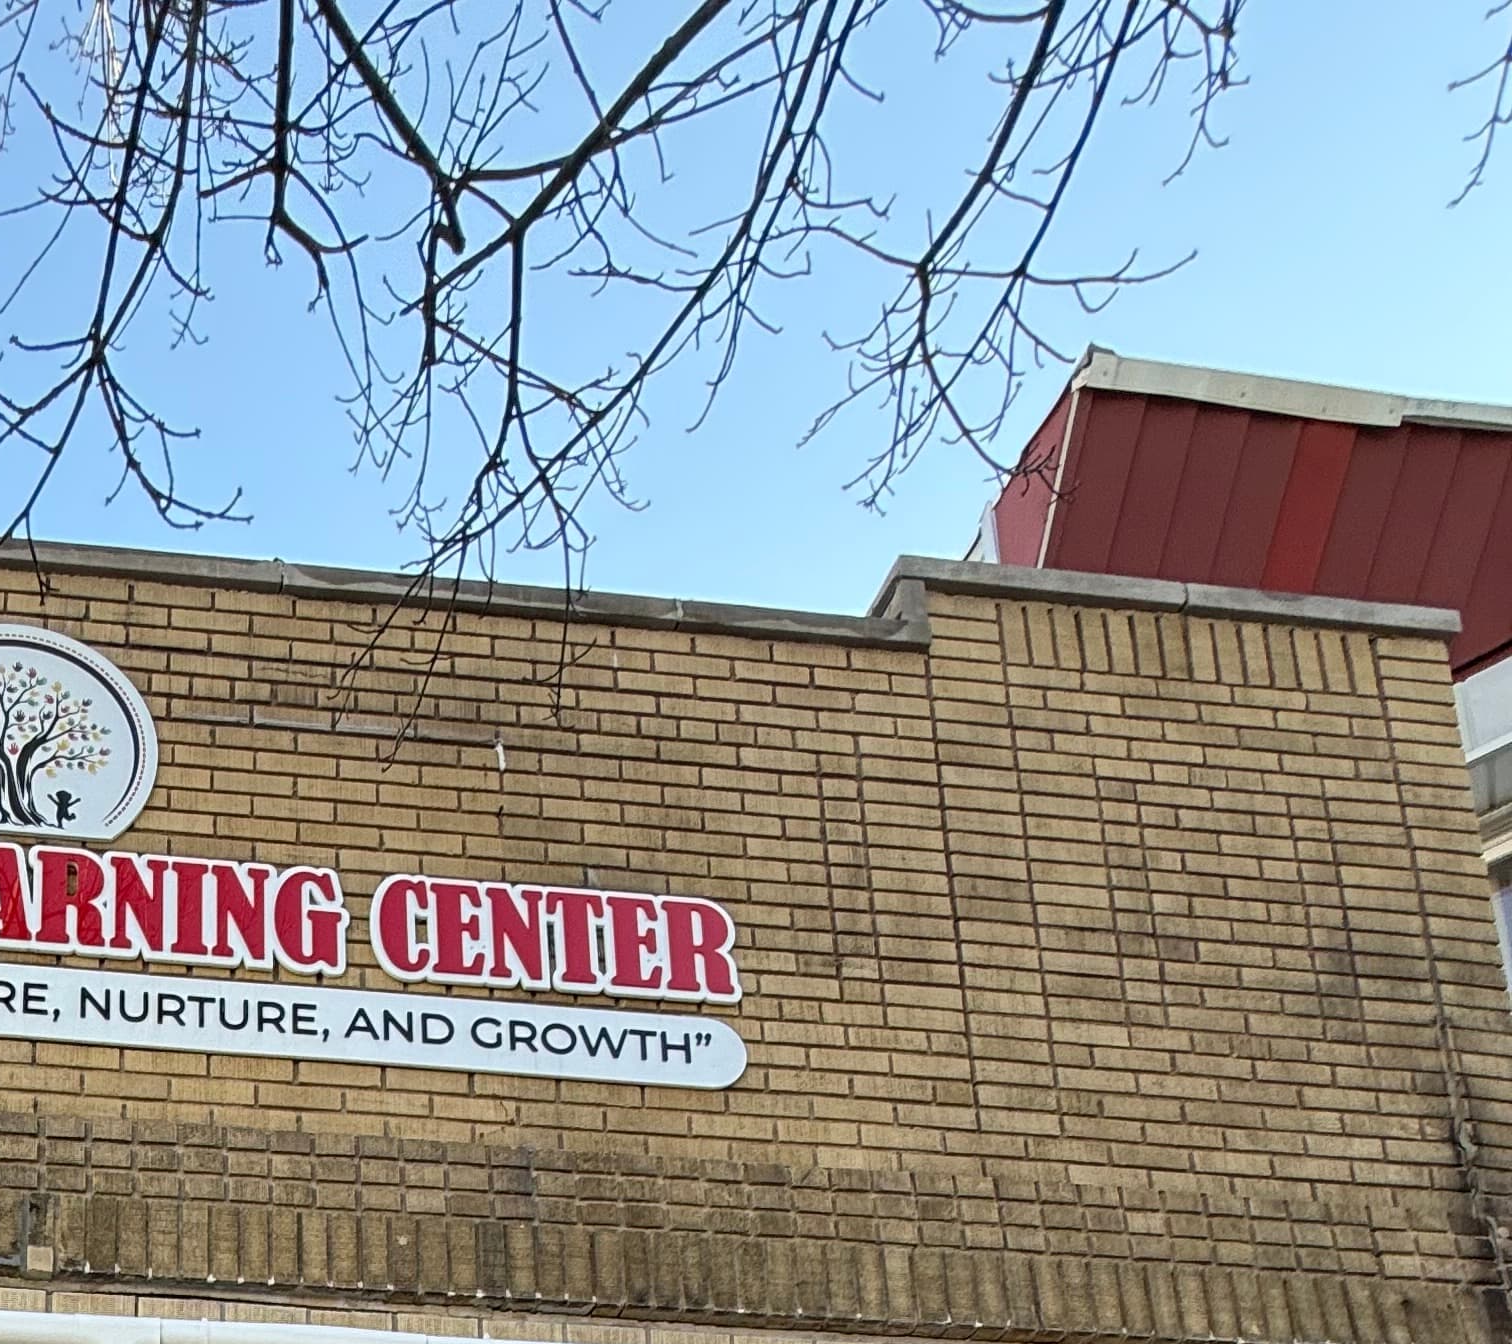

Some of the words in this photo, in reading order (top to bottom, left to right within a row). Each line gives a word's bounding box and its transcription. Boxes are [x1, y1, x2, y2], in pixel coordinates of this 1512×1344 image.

[378, 879, 732, 995] CENTER
[80, 987, 329, 1042] NURTURE,
[344, 1008, 454, 1045] AND
